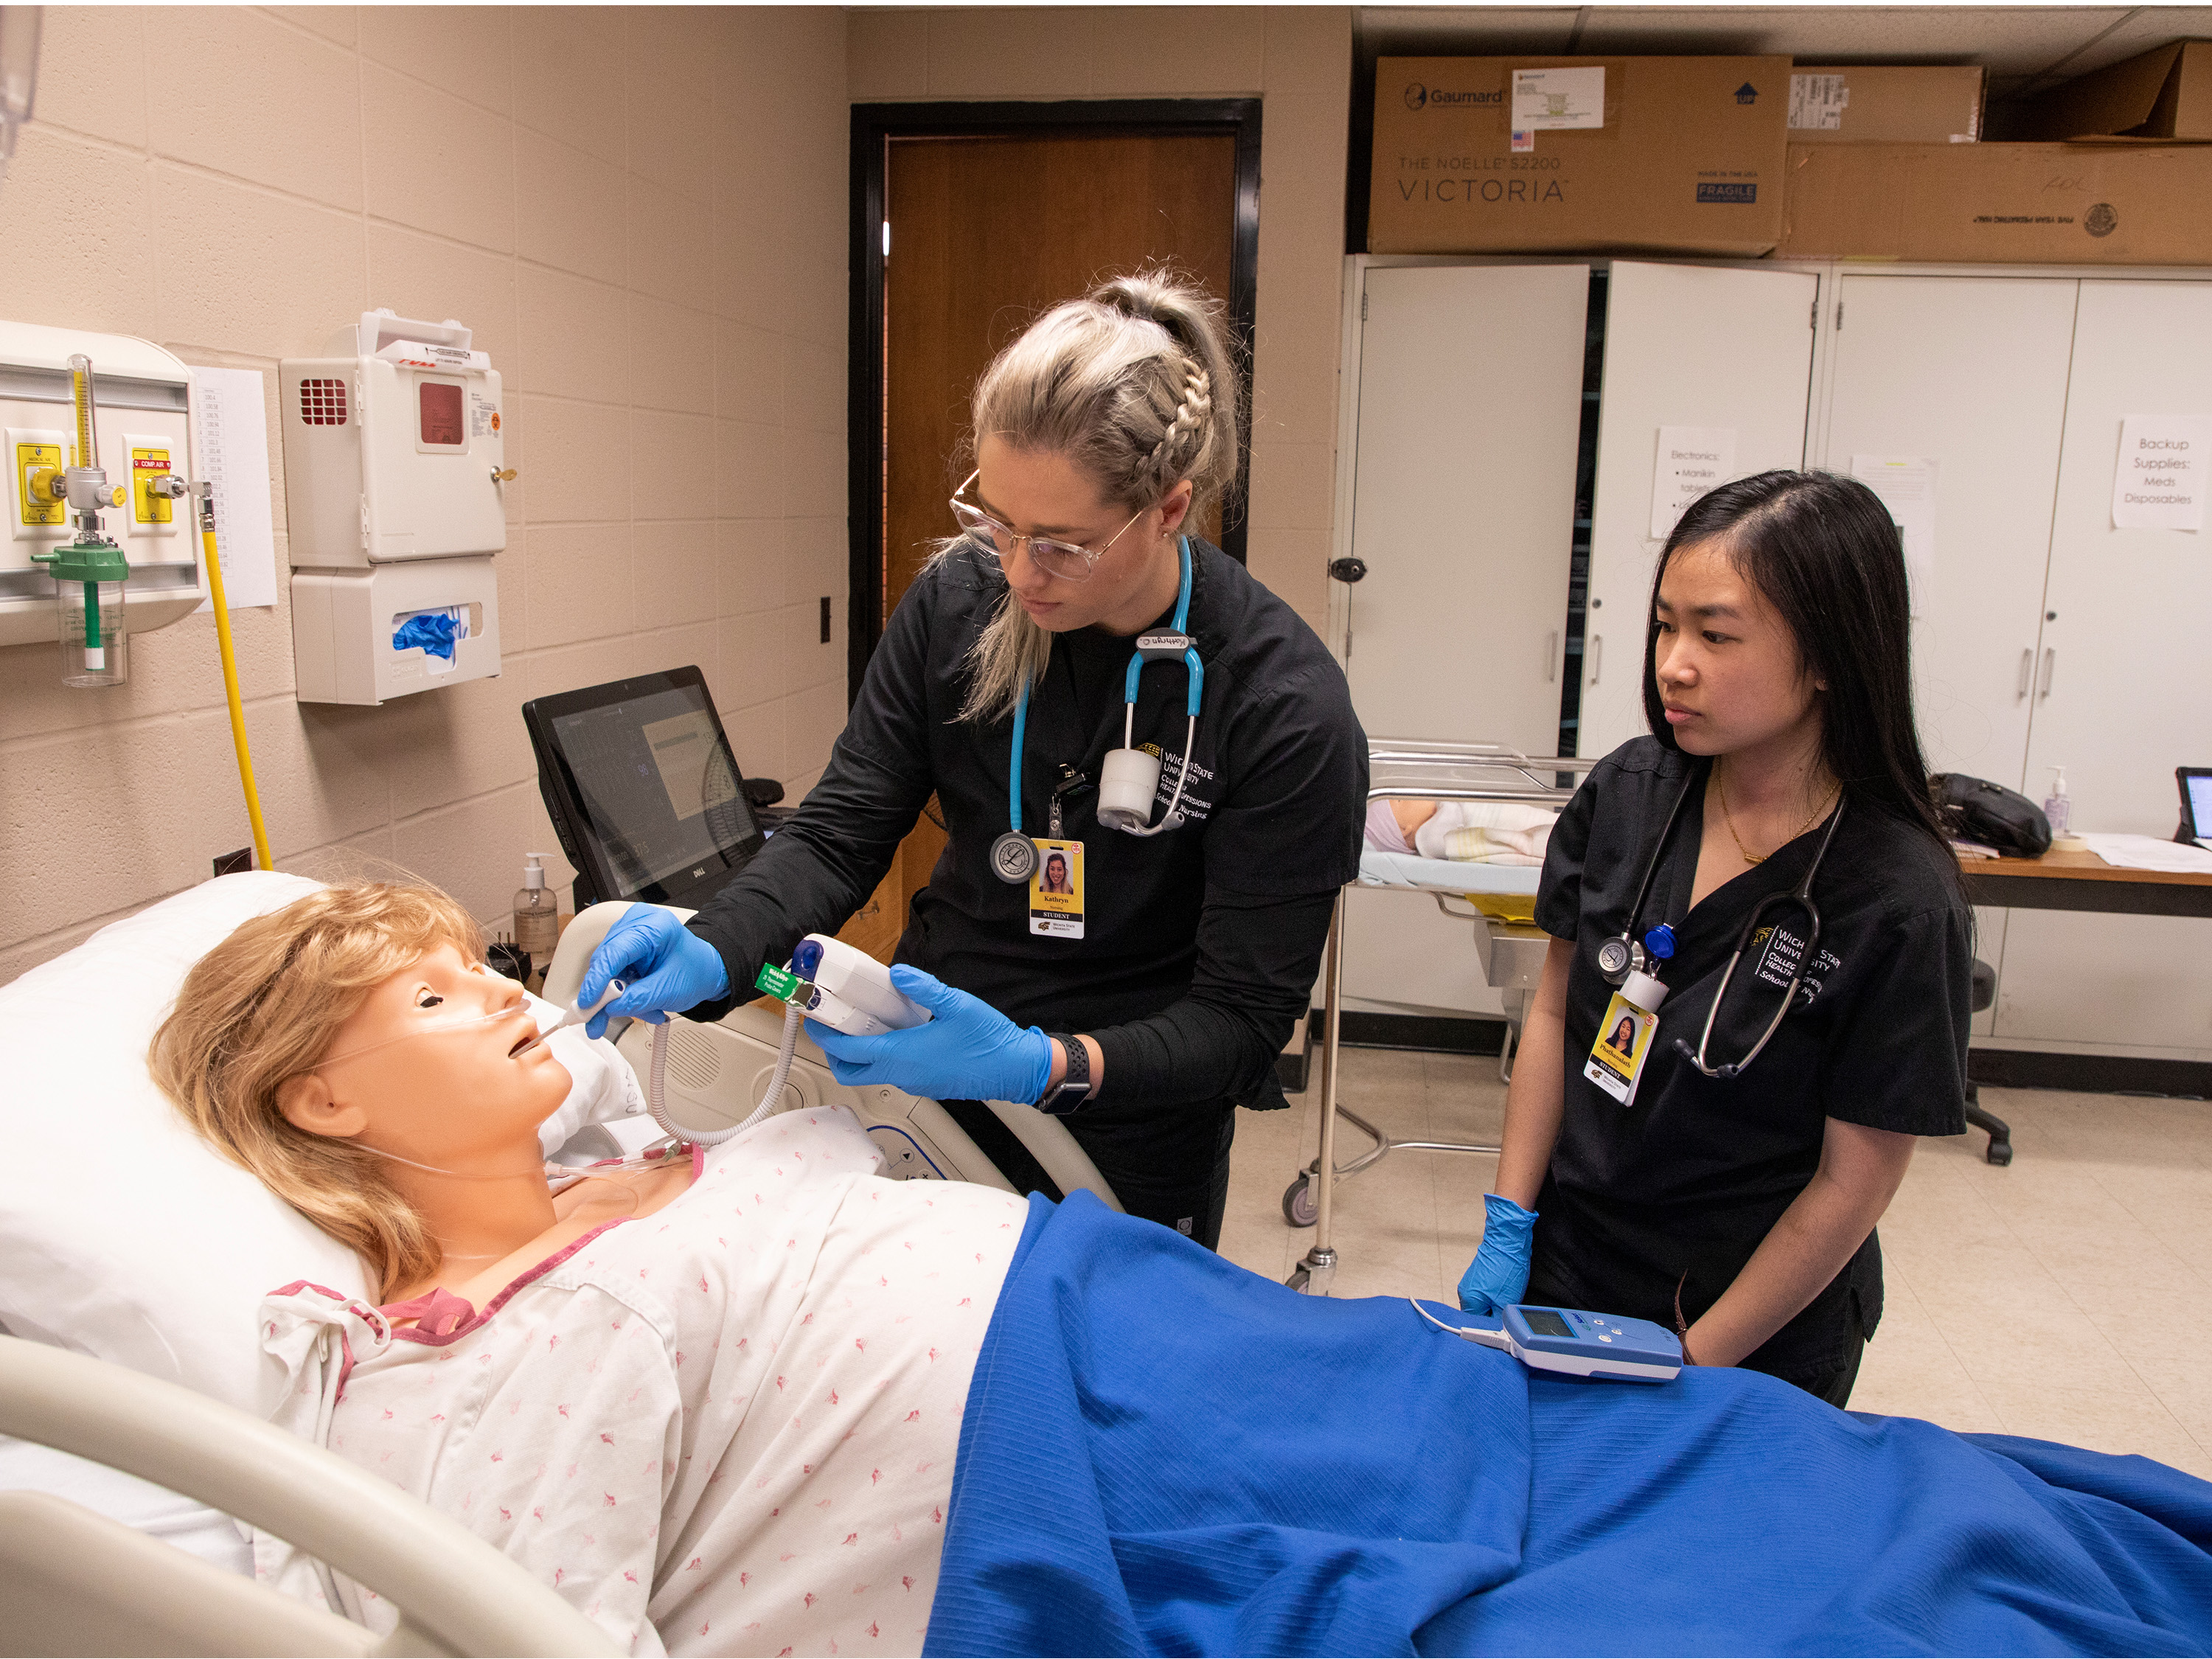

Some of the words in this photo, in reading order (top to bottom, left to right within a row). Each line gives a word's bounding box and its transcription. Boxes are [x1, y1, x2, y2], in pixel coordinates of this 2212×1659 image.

[1430, 89, 1503, 103] Gaumard
[1739, 95, 1753, 104] UP
[1400, 157, 1430, 170] THE
[1511, 157, 1561, 170] S2200
[1398, 179, 1564, 202] VICTORIA
[1699, 185, 1755, 195] FRAGILE
[2140, 438, 2190, 451] Backup
[1672, 450, 1720, 461] Electronics:
[2134, 457, 2191, 470] Supplies:
[1683, 470, 1715, 478] Manikin
[2143, 477, 2176, 487] Meds
[2124, 493, 2192, 504] Disposables
[1152, 636, 1186, 647] Kathryn
[1164, 762, 1200, 785] UNIVSITY
[1193, 763, 1214, 780] STATE
[1155, 793, 1172, 807] Schoo
[1179, 804, 1208, 819] Nursing
[1180, 793, 1211, 809] OFESSIONS
[692, 866, 706, 878] DELL
[1778, 929, 1805, 950] WICH
[1768, 952, 1797, 970] COLLEG
[1765, 959, 1793, 977] HEALTH
[767, 976, 785, 988] Thermometer
[1759, 970, 1789, 988] School
[764, 981, 773, 990] Probe
[772, 985, 782, 994] Covers
[1599, 1043, 1632, 1069] Phathanalath
[1599, 1061, 1621, 1079] STUDENT
